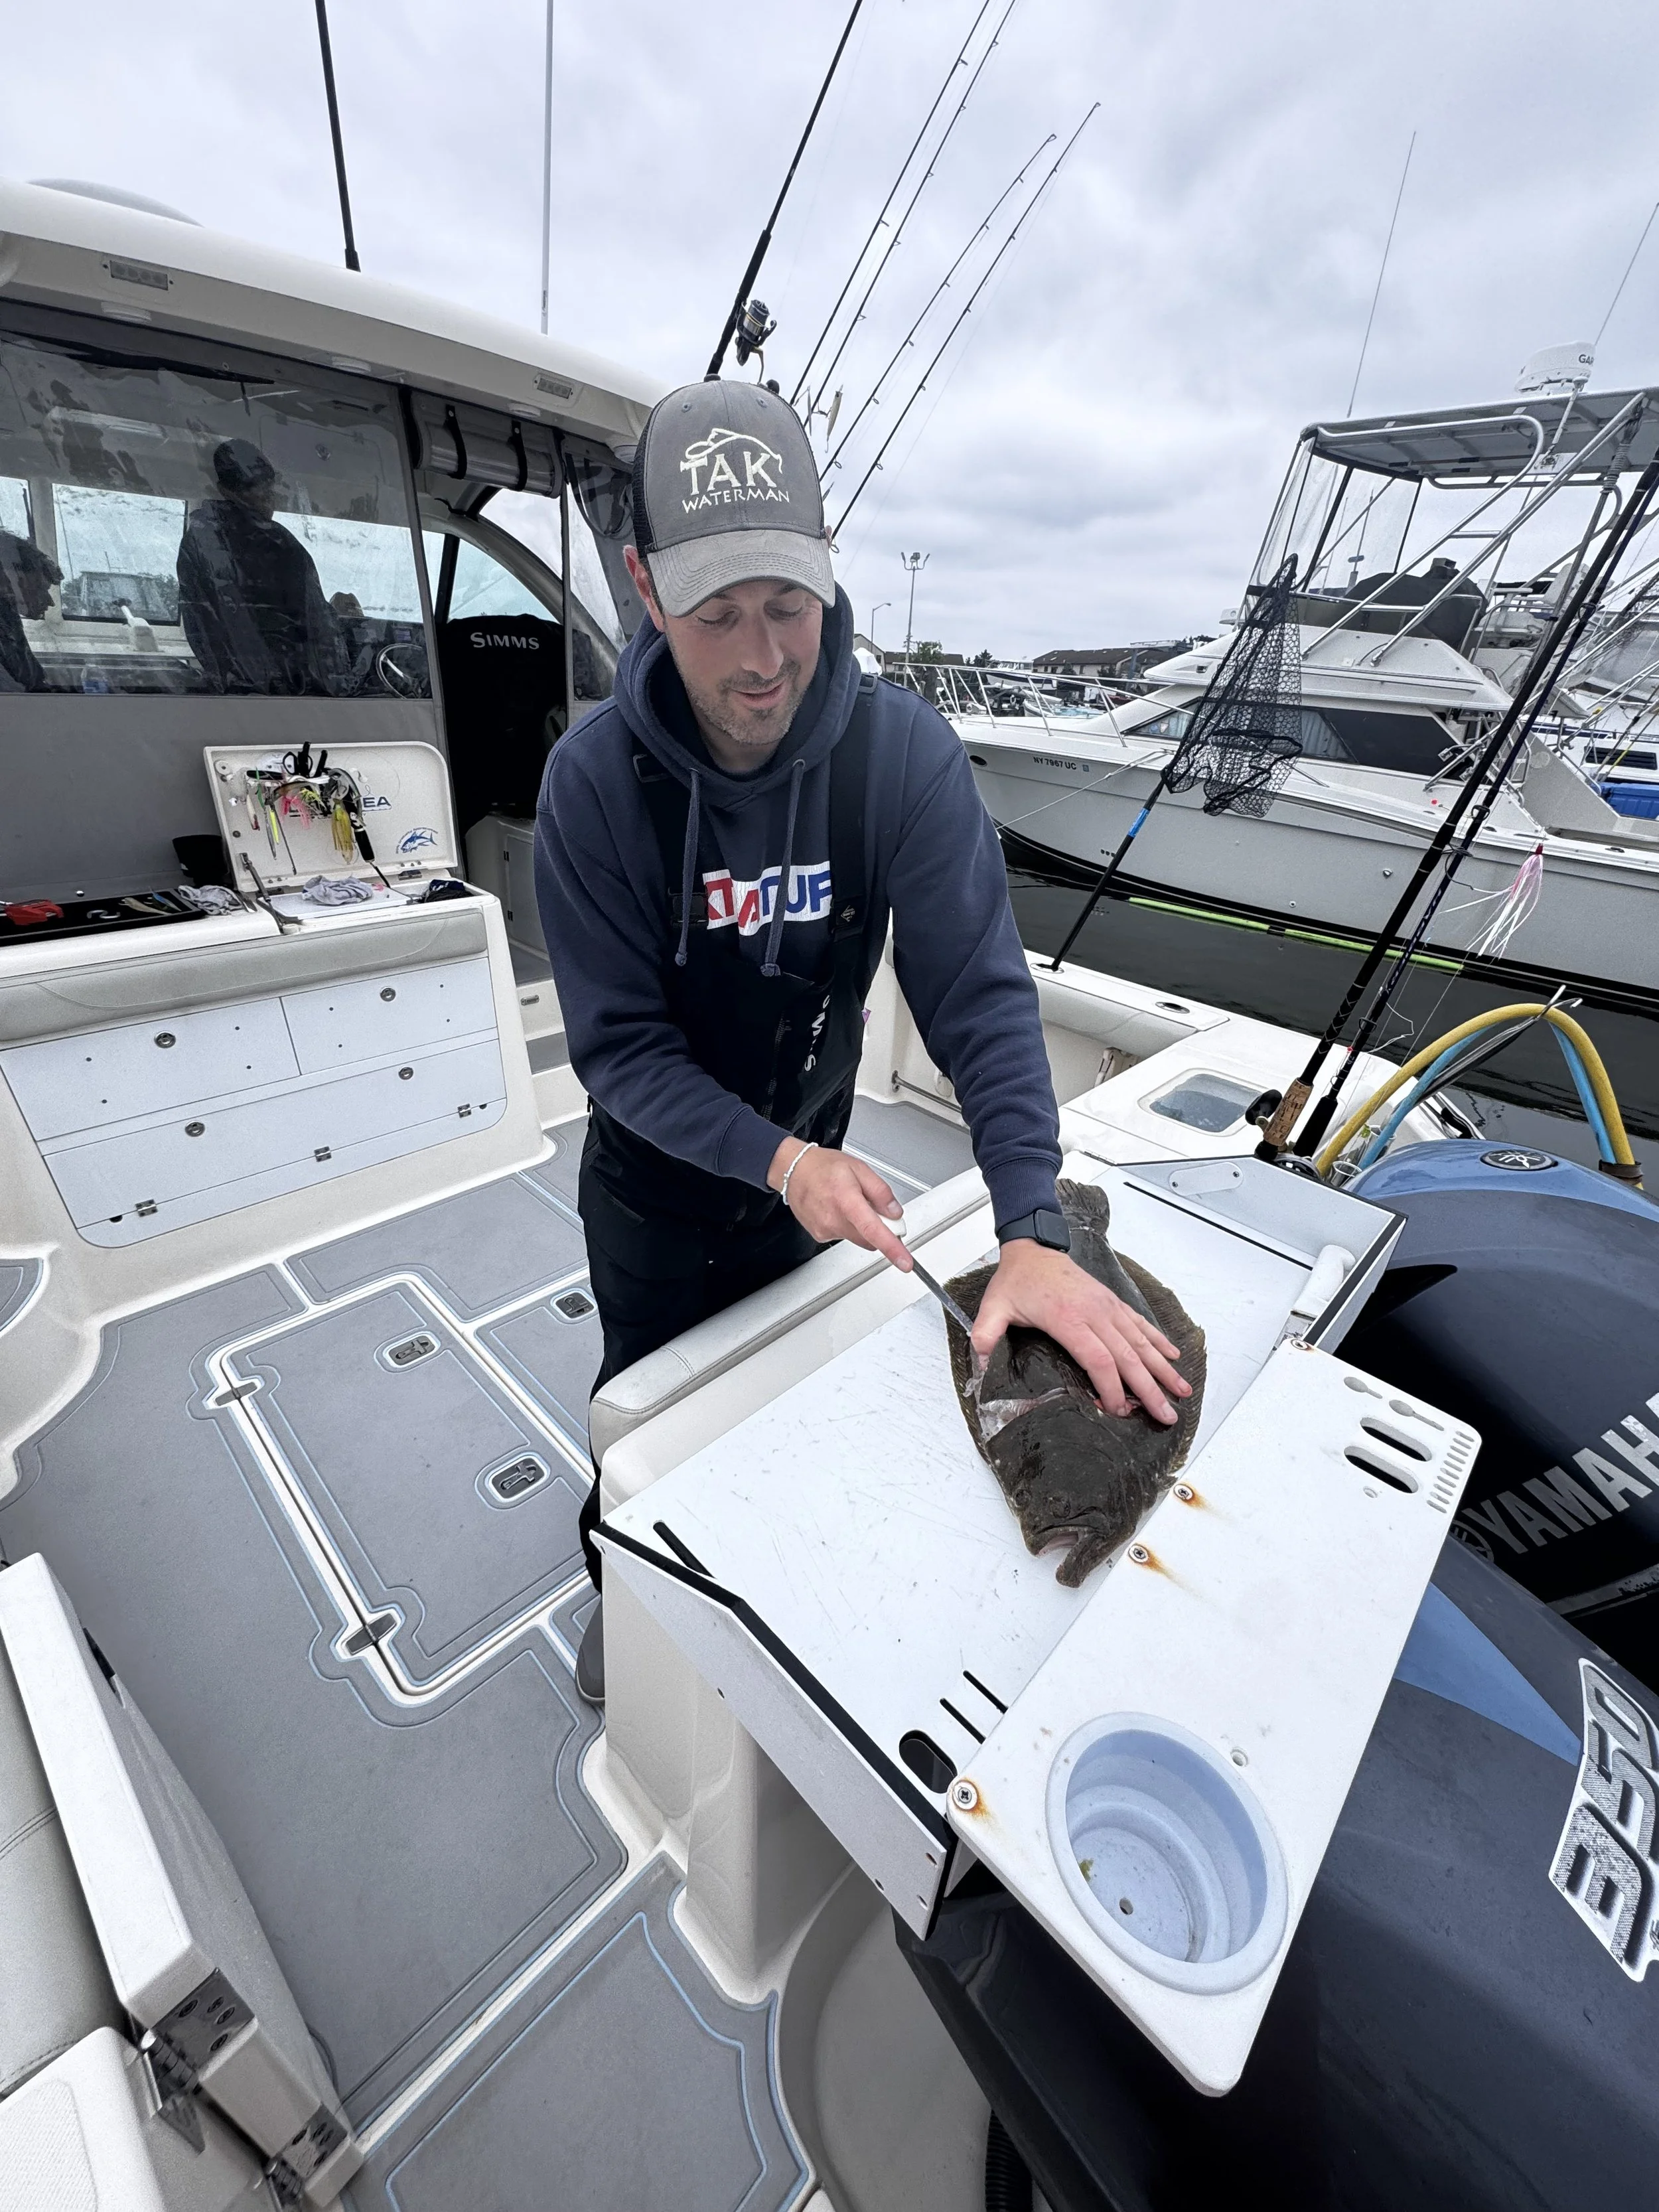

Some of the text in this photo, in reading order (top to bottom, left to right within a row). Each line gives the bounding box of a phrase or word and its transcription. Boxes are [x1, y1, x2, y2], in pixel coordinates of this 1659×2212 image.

[680, 451, 777, 496] TAK
[682, 488, 790, 514] WATERMAN
[470, 632, 540, 650] SIMMS
[1044, 758, 1063, 768] 7967
[1064, 761, 1077, 770] UC
[1461, 1392, 1659, 1554] YAMAH
[1551, 1664, 1658, 1964] 350
